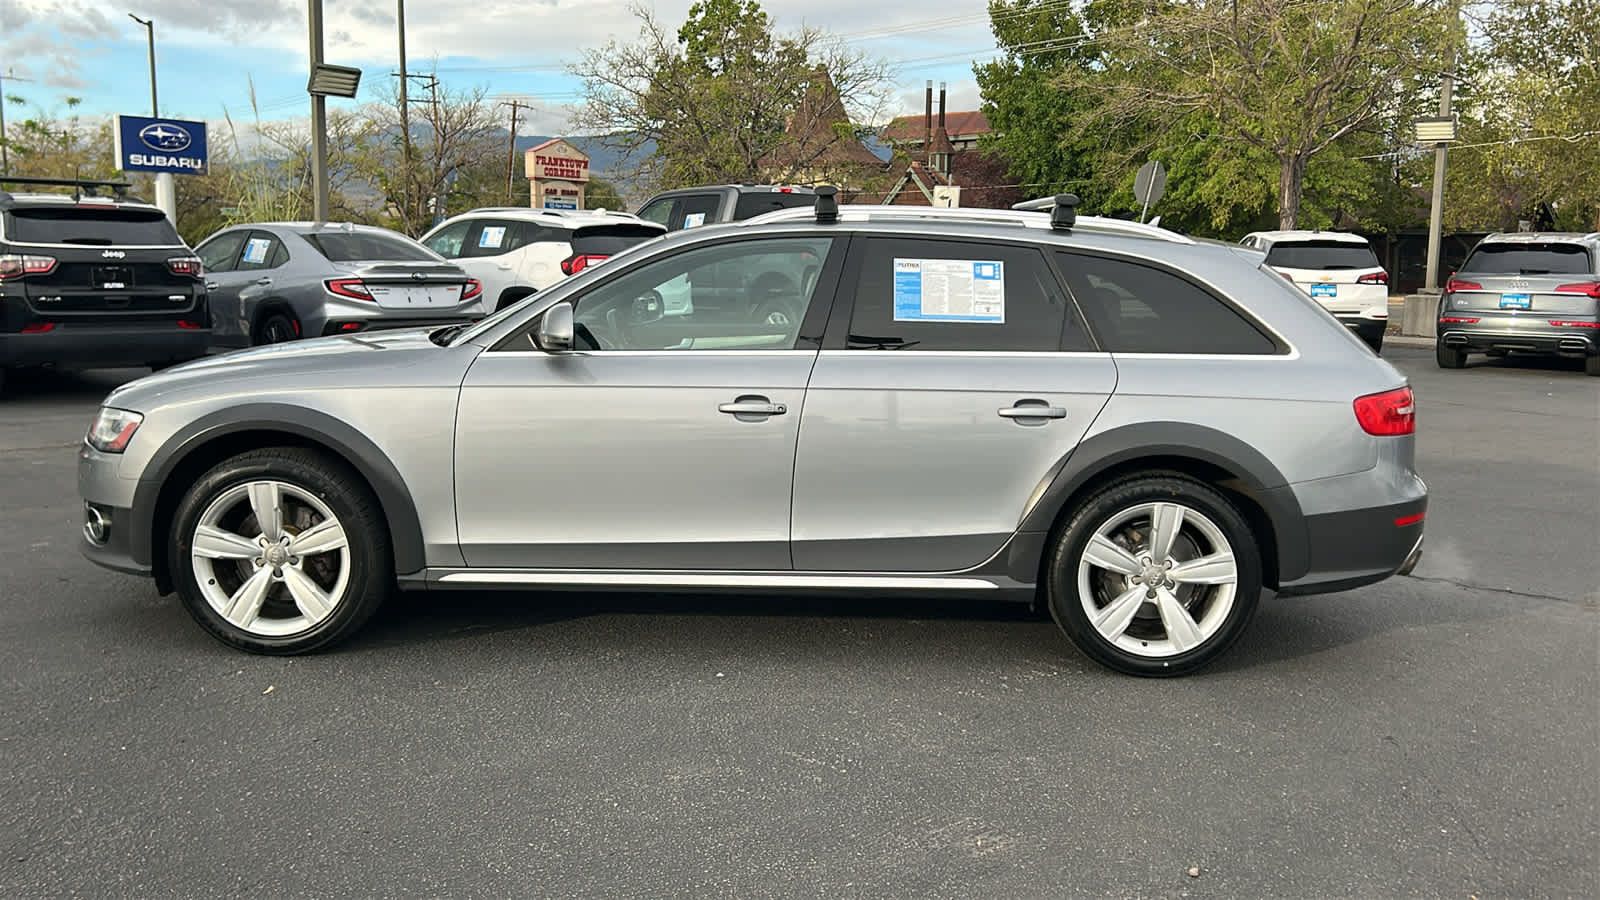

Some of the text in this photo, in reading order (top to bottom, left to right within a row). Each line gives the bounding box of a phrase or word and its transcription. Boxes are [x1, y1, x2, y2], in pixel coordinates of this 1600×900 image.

[129, 154, 202, 169] SUBARU
[535, 156, 588, 169] FRANKTOWN
[544, 167, 581, 178] CORNERS
[102, 250, 125, 259] Jeep
